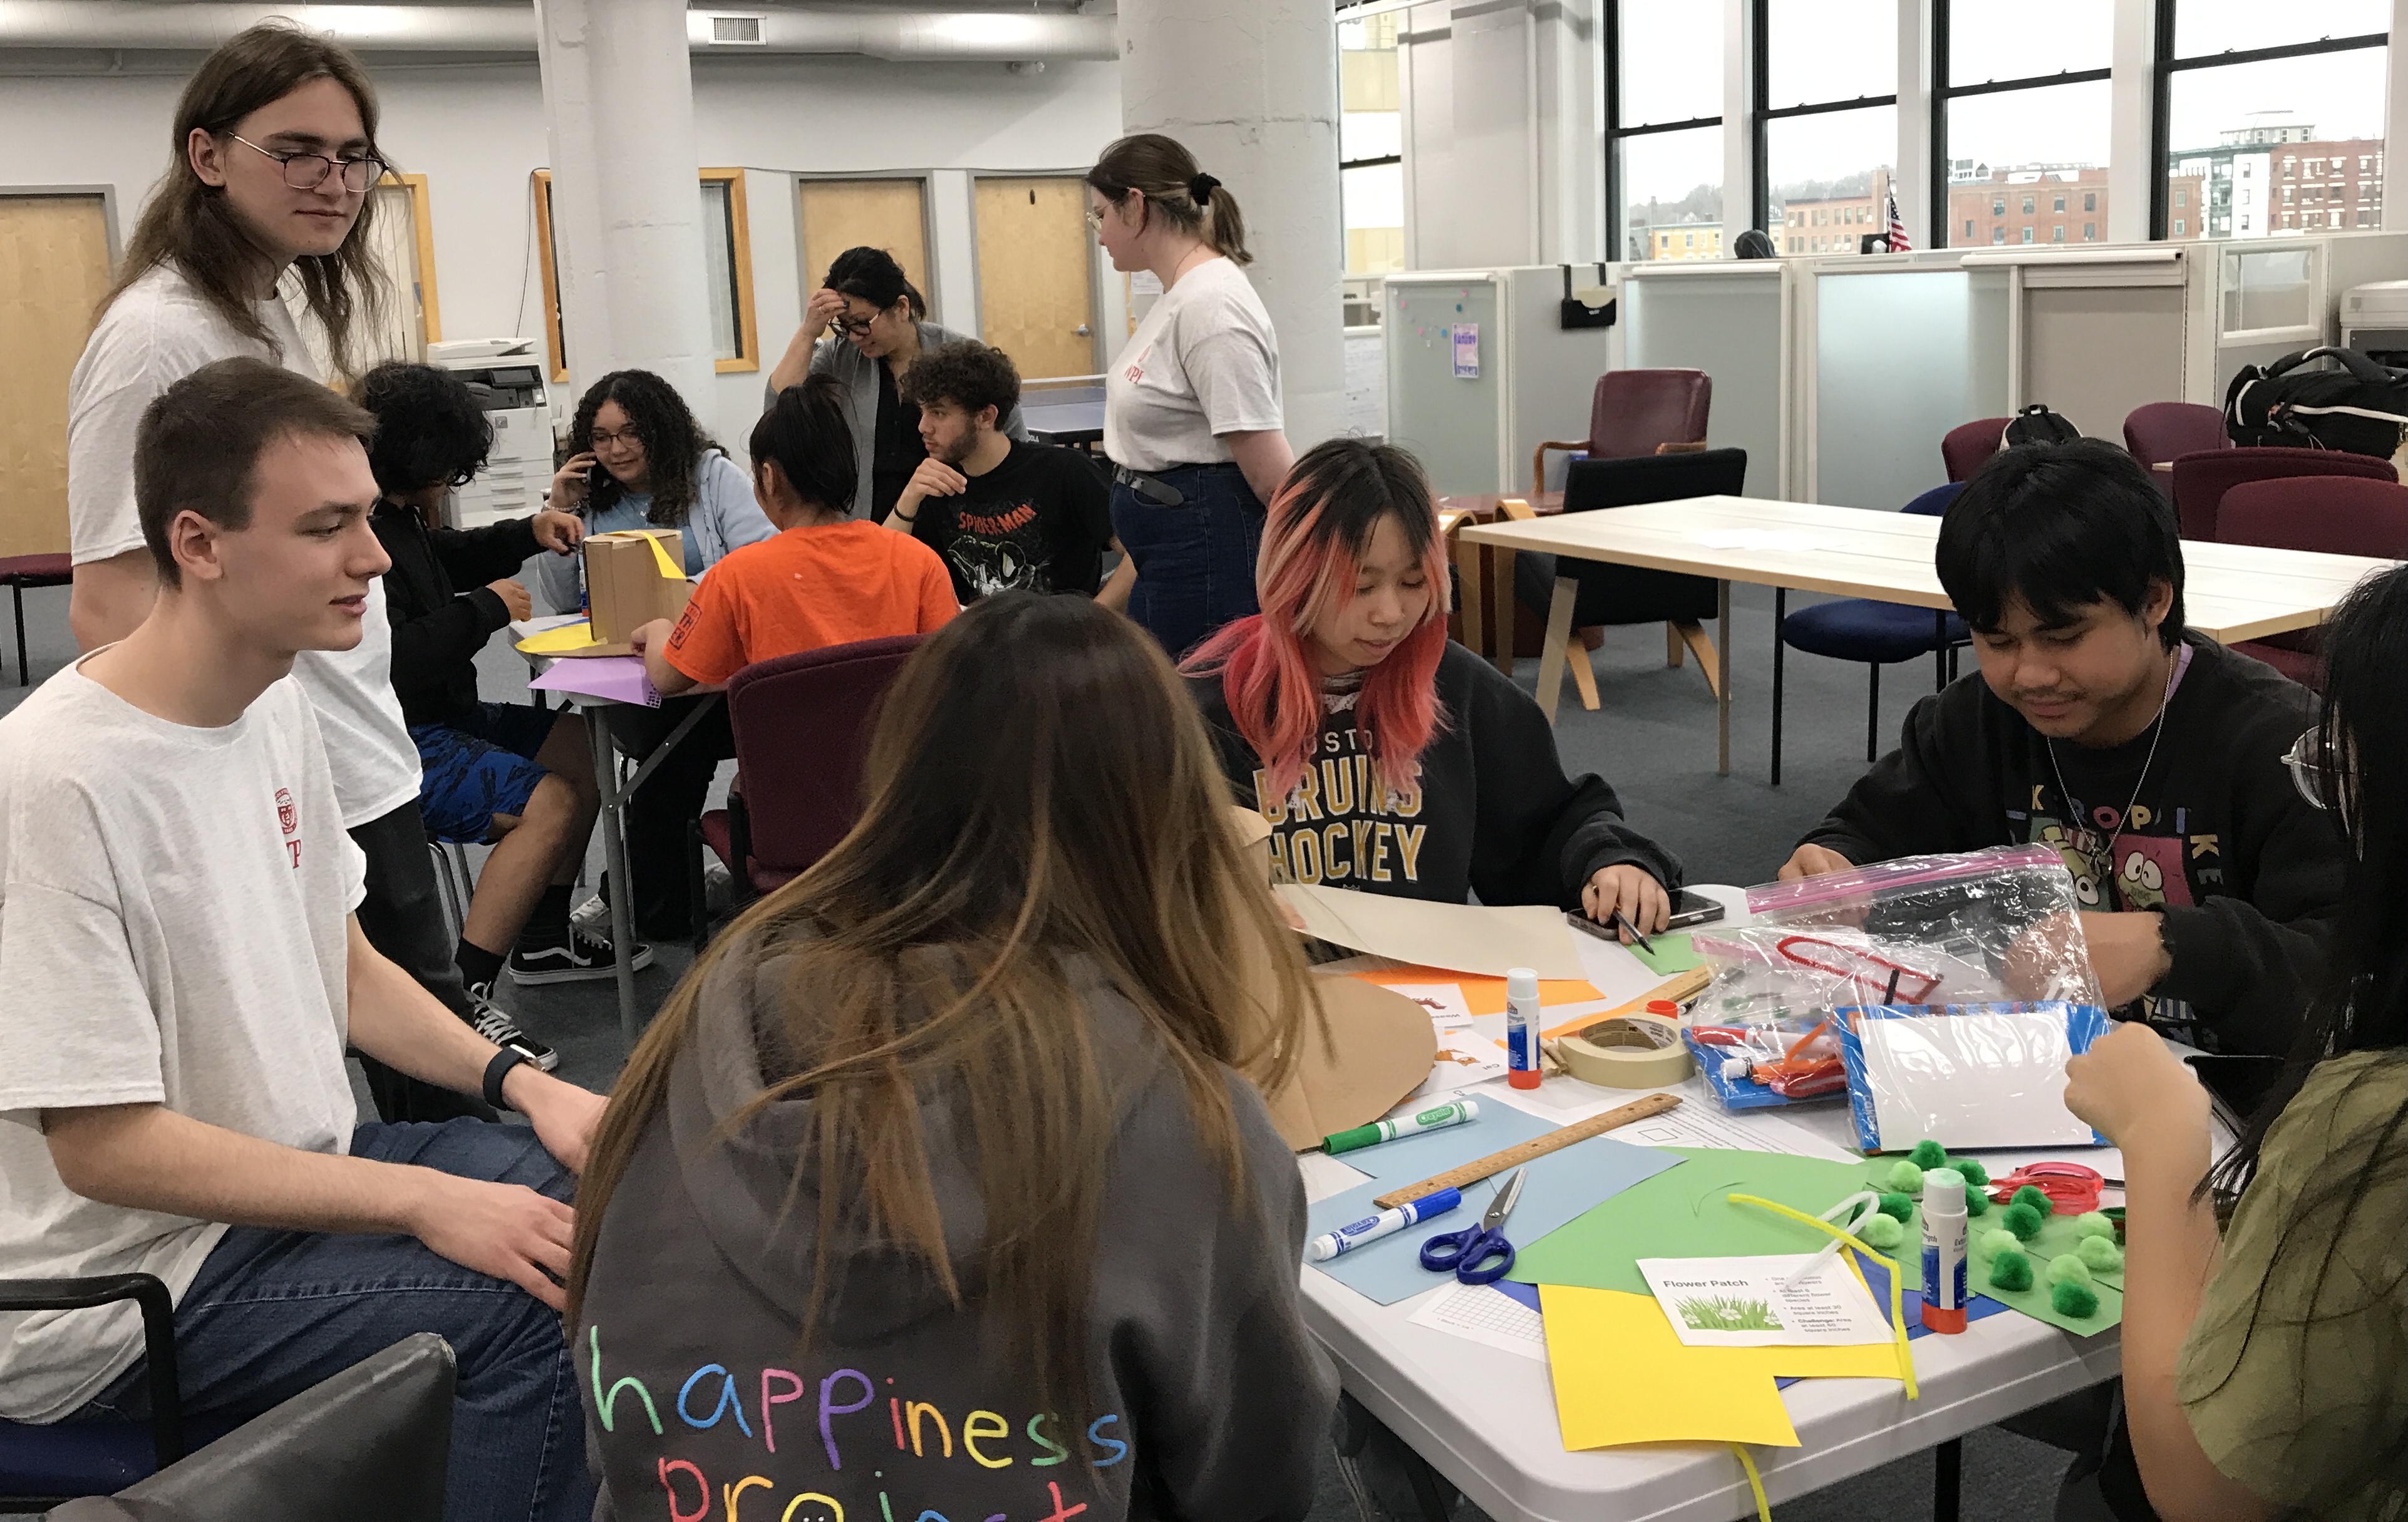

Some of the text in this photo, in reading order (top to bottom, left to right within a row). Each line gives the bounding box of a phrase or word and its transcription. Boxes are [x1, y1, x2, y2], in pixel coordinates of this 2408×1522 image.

[1268, 819, 1428, 885] HOCKEY
[1418, 1107, 1451, 1124] Crayola
[1343, 1218, 1378, 1233] Crayola
[589, 1324, 1129, 1471] happiness
